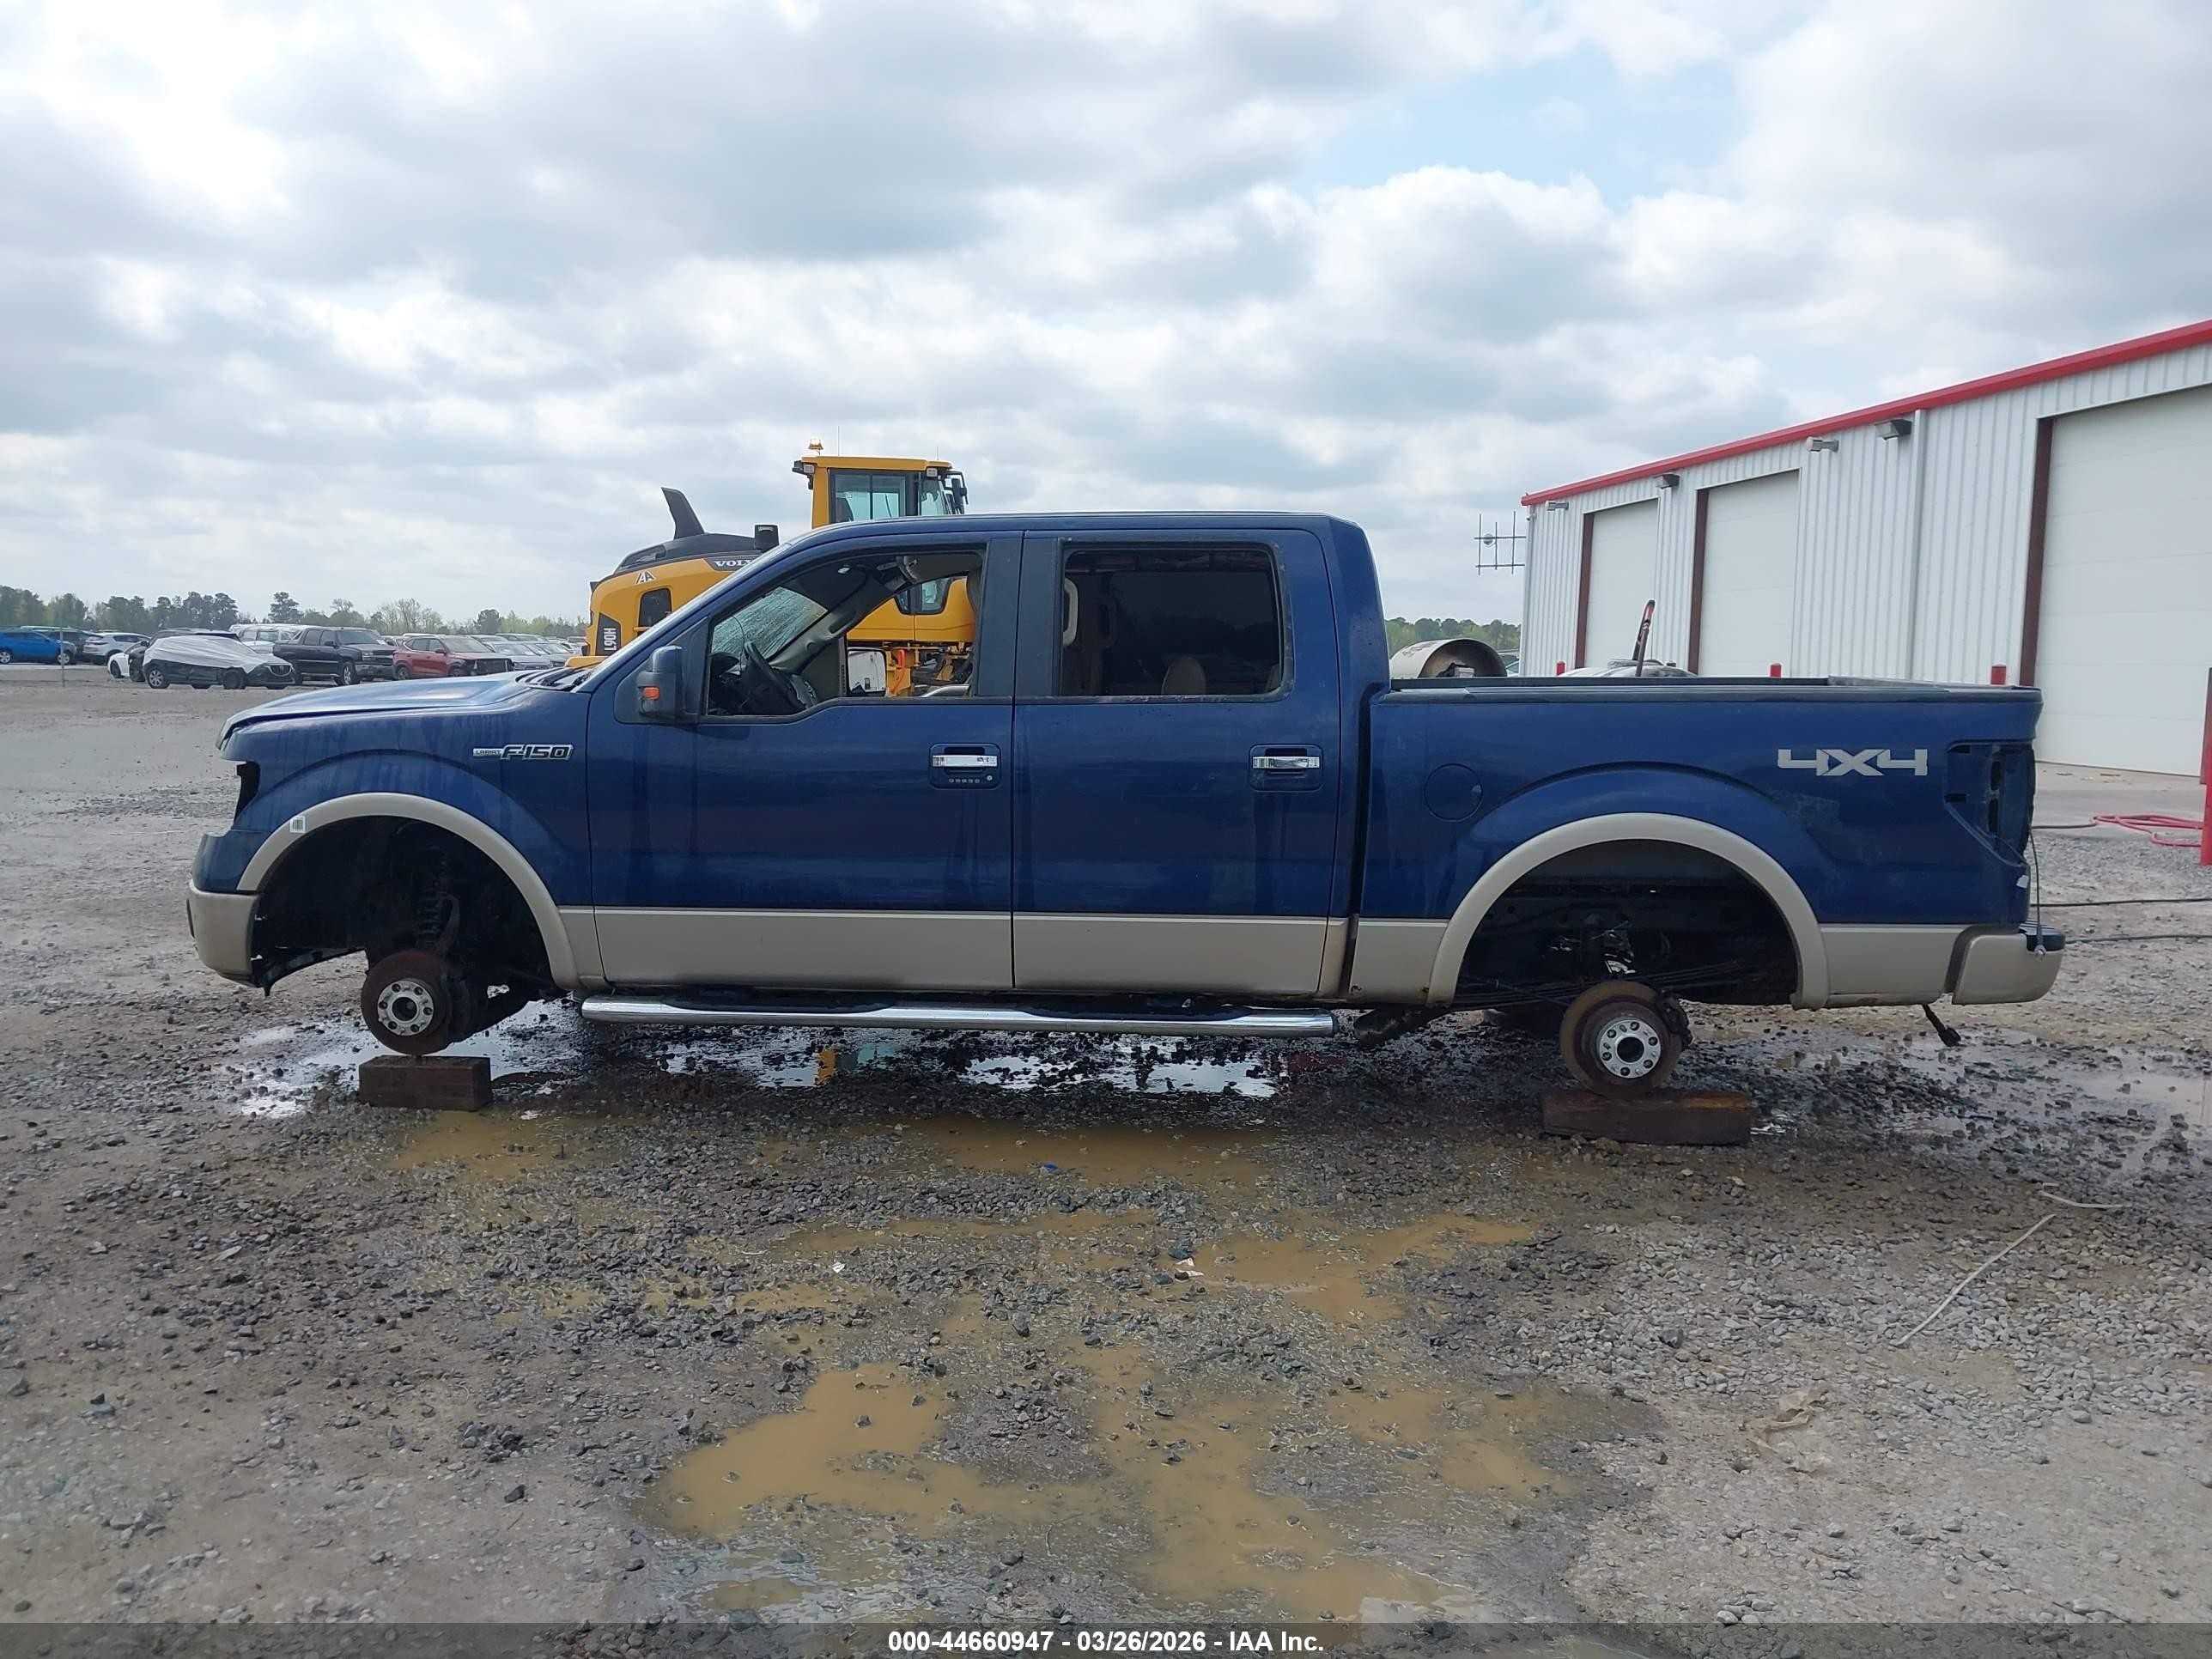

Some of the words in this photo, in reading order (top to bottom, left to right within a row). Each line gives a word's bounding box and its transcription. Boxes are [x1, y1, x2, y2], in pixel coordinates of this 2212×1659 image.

[714, 559, 754, 568] VOLV
[603, 627, 617, 652] L90H
[500, 744, 574, 759] F-150
